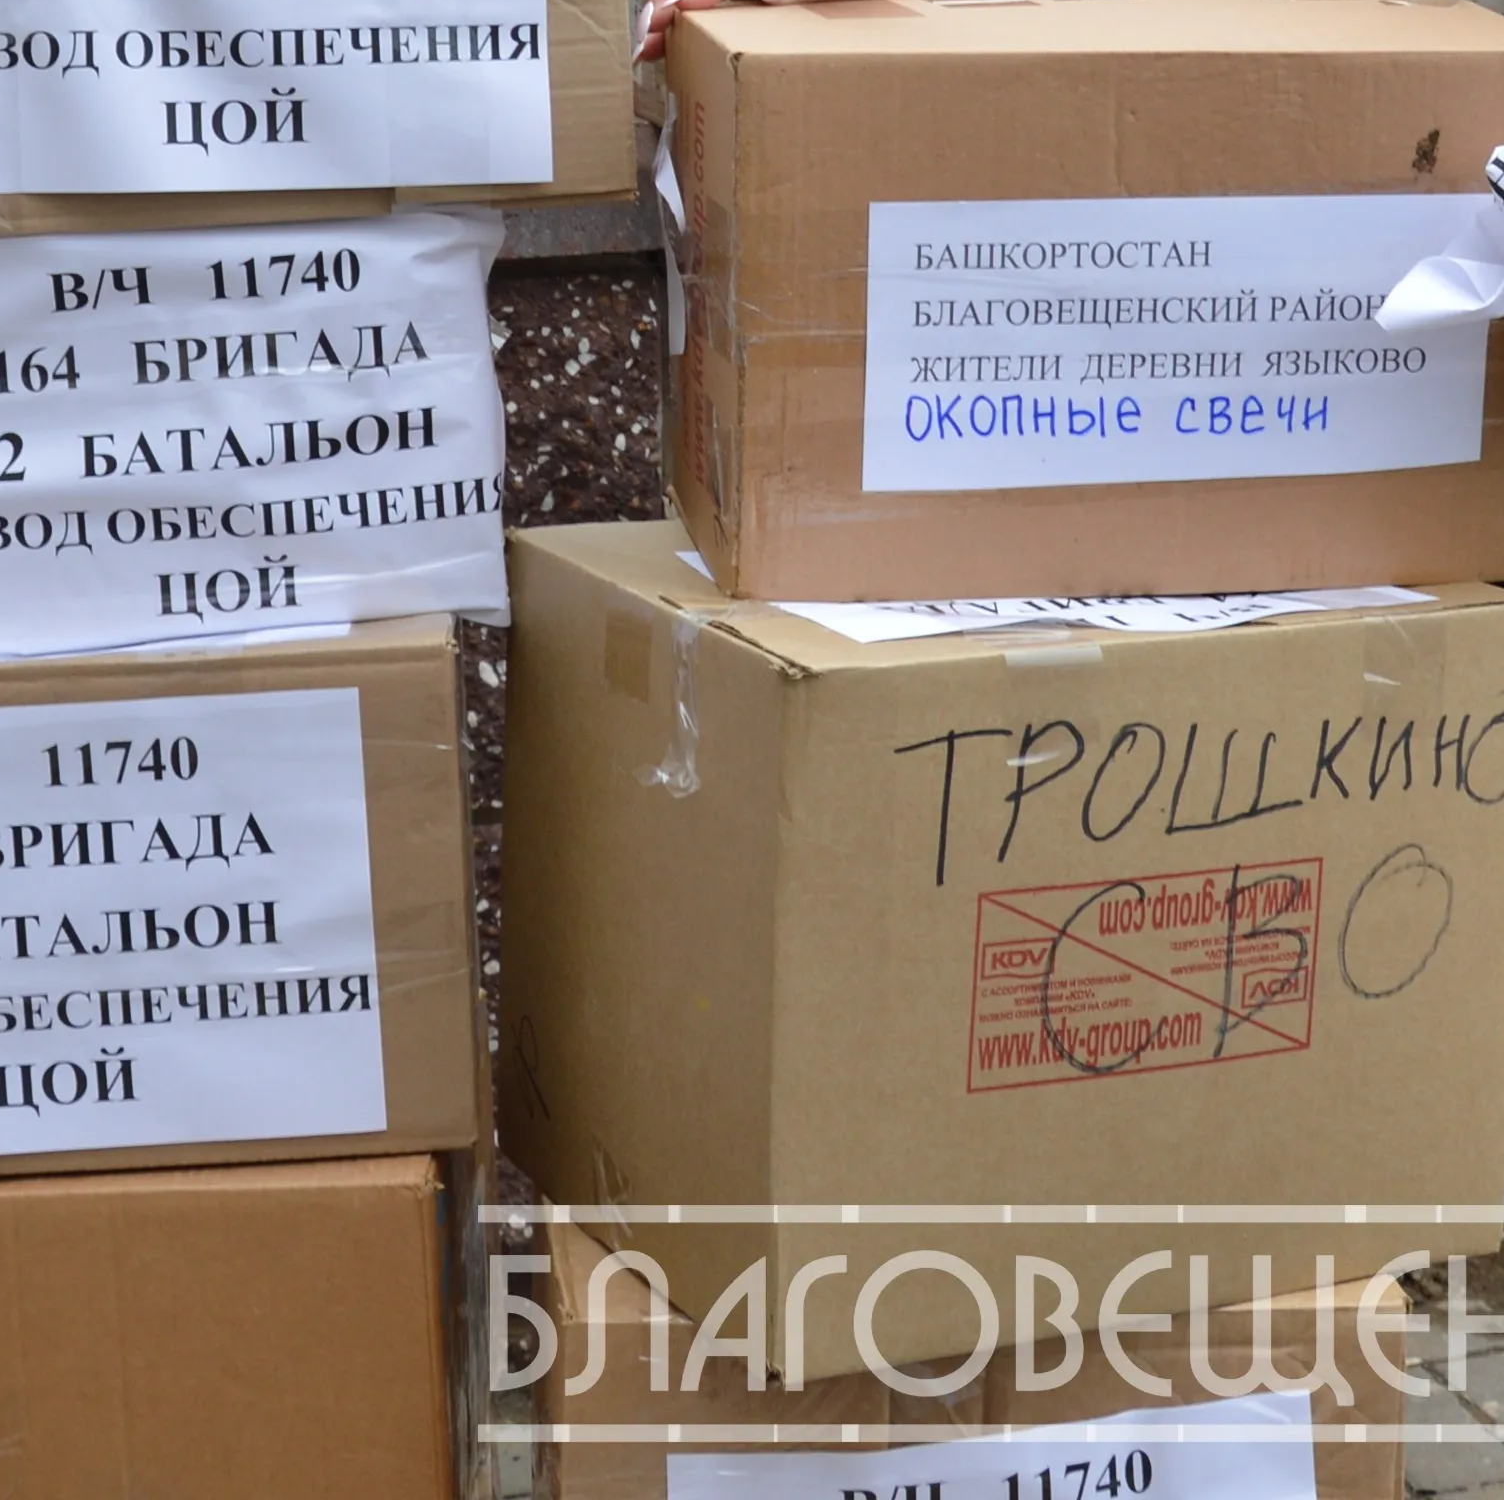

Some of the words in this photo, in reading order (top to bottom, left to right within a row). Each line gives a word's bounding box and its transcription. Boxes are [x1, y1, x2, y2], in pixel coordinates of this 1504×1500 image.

[114, 22, 541, 70] ОБЕСПЕЧЕНИЯ
[163, 85, 307, 156] ЦОЙ
[49, 266, 152, 314] В/Ч
[208, 247, 362, 302] 11740
[915, 240, 1211, 271] БАШКОРТОСТАН
[914, 287, 1258, 330] БЛАГОВЕЩЕНСКИЙ
[1269, 287, 1387, 323] РАЙОН
[131, 320, 429, 386] БРИГАДА
[909, 353, 1062, 384] ЖИТЕЛИ
[1079, 350, 1243, 385] ДЕРЕВНИ
[1262, 345, 1428, 378] ЯЗЫКОВО
[81, 406, 436, 479] БАТАЛЬОН
[156, 552, 299, 623] ЦОЙ
[44, 735, 200, 788] 11740
[990, 947, 1050, 971] KDV
[977, 1011, 1204, 1072] www.kdv-group.com
[1003, 1448, 1154, 1500] 11740
